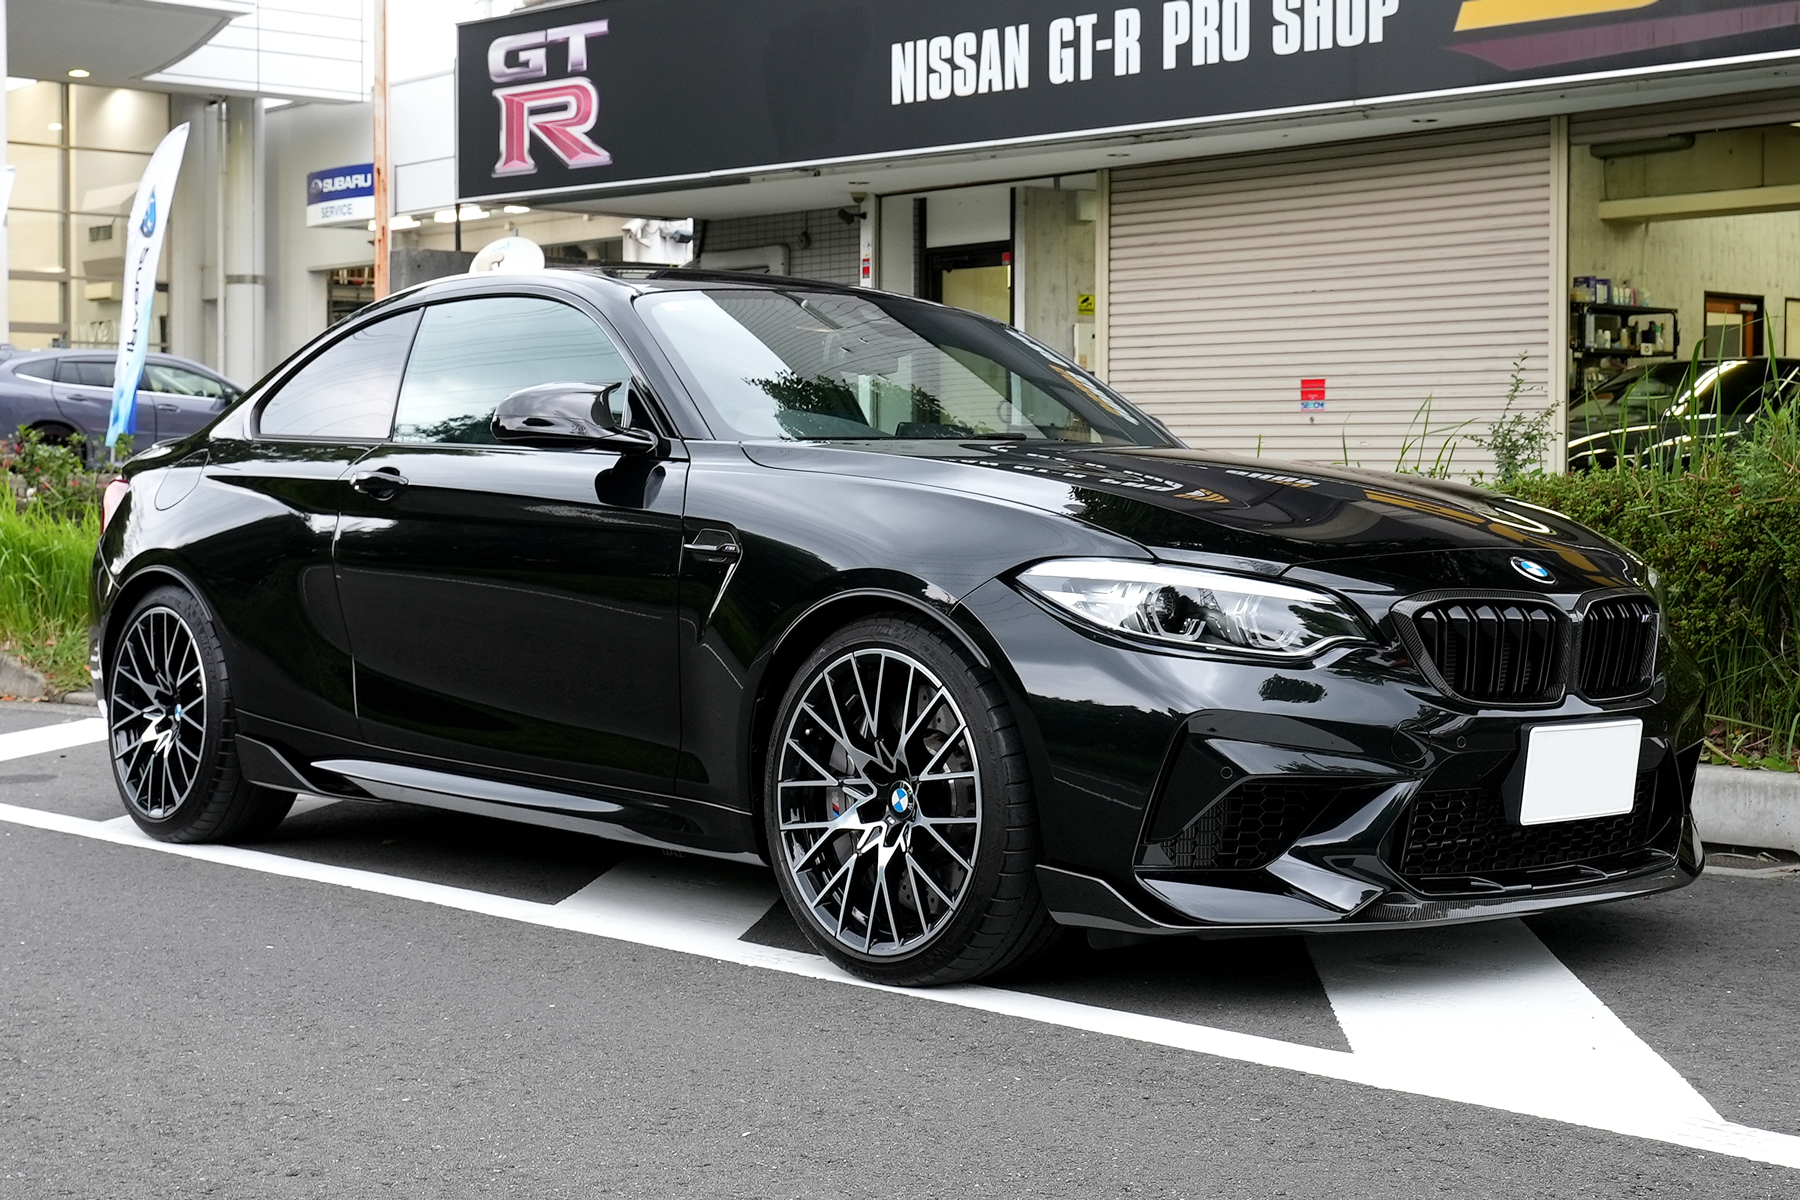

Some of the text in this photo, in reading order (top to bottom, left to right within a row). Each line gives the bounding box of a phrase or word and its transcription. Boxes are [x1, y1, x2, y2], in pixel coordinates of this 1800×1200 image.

[488, 19, 609, 83] GT
[891, 0, 1400, 106] NISSAN GT-R PRO SHOP
[491, 76, 613, 178] R
[321, 203, 353, 219] SERVICE
[322, 173, 372, 193] SUBARU
